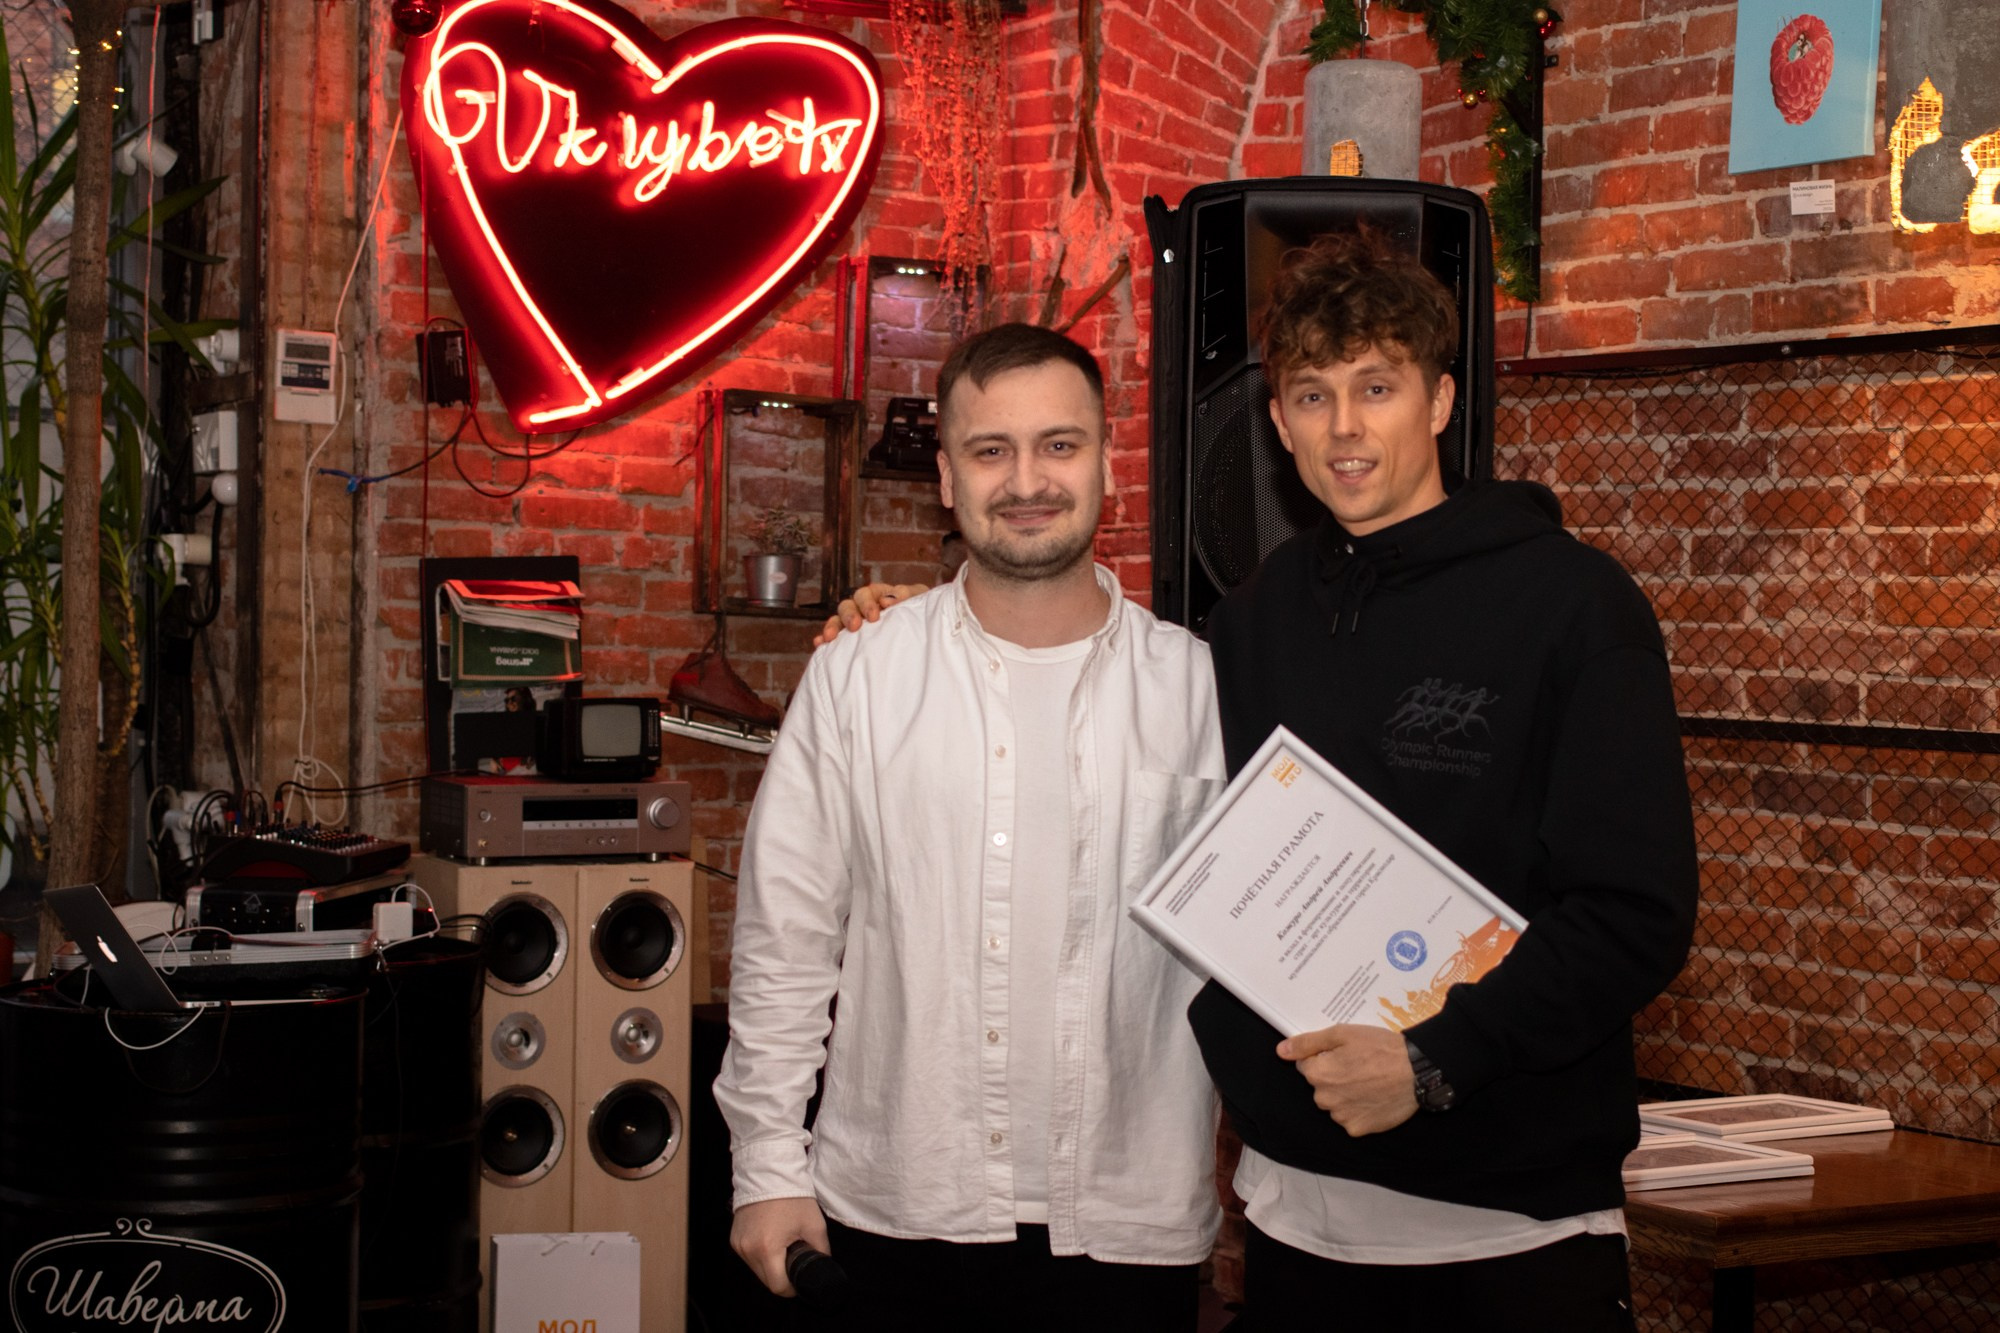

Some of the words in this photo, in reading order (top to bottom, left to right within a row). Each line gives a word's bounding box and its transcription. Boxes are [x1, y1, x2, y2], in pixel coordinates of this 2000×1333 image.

[1380, 737, 1433, 755] Olympic
[1437, 744, 1492, 763] Runners
[1387, 753, 1482, 778] Championship
[1282, 766, 1303, 788] KRD
[1229, 859, 1282, 919] ПОЧЁТНАЯ
[1277, 808, 1324, 862] ГРАМОТА
[1274, 853, 1322, 908] НАГРАЖДАЕТСЯ
[1300, 885, 1324, 913] Андрей
[1321, 850, 1354, 888] Андреевич
